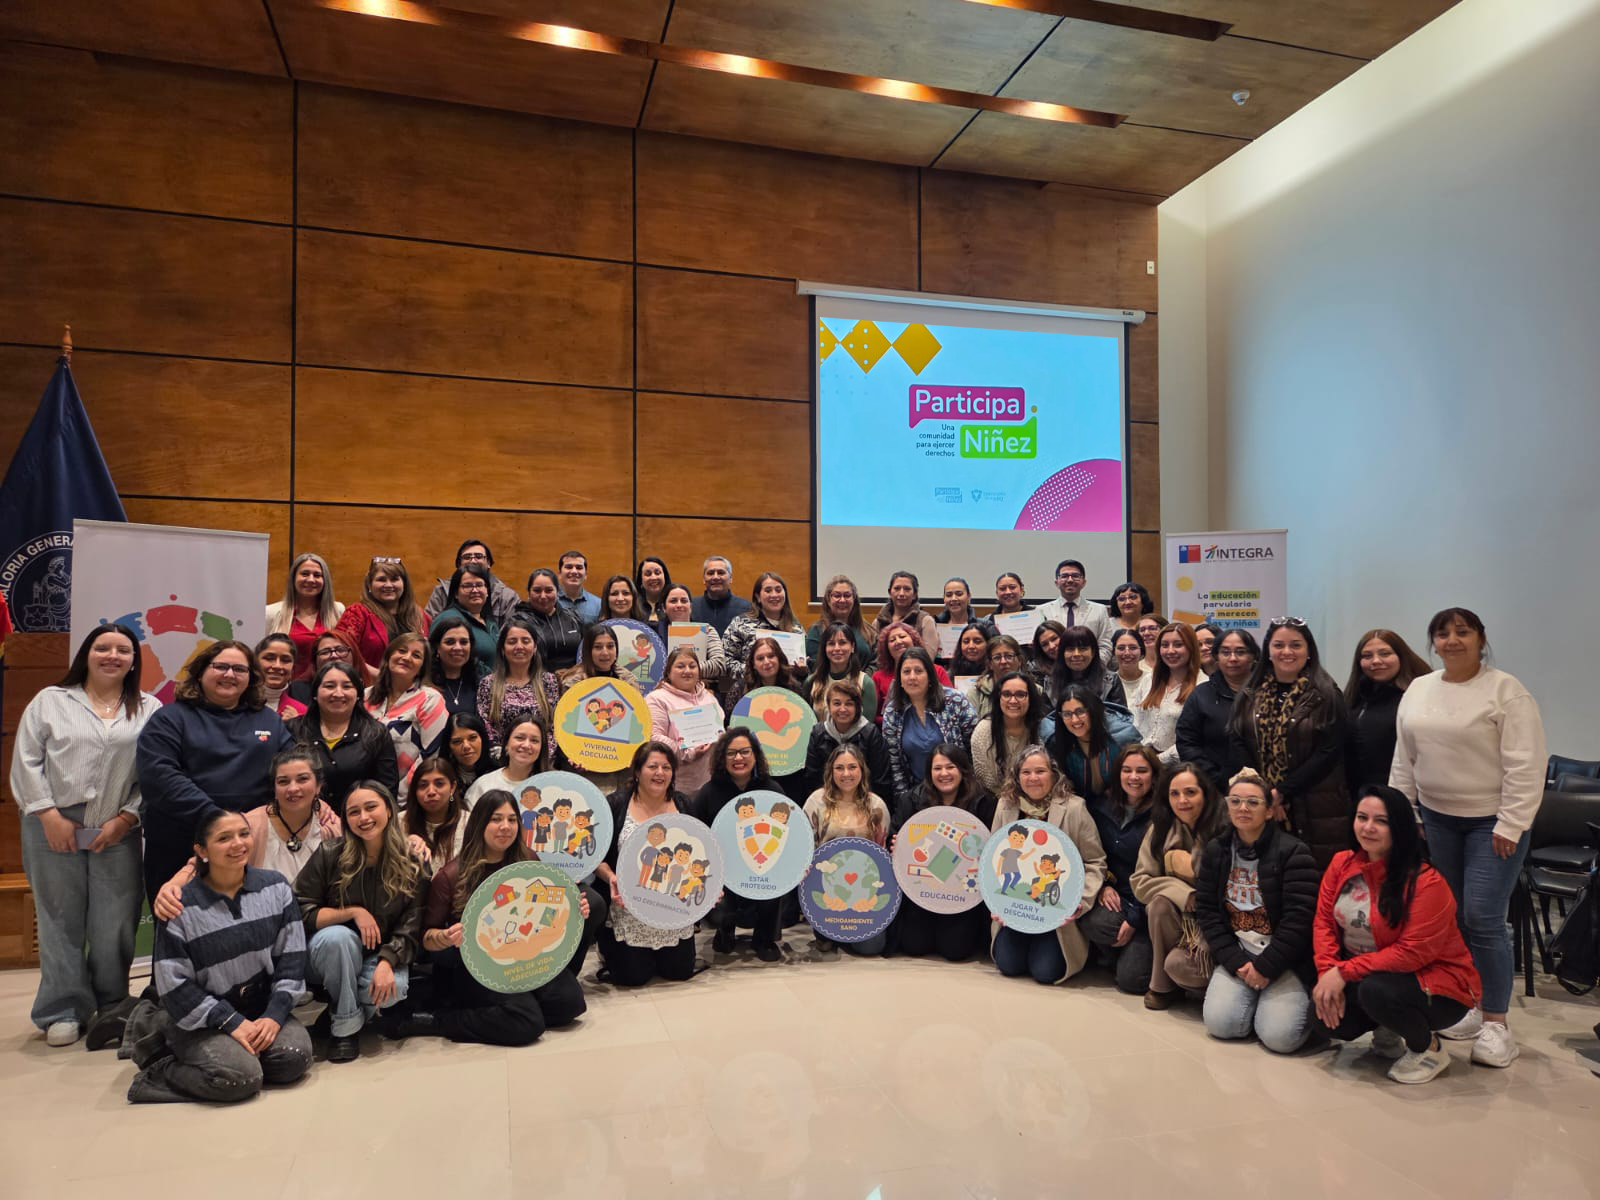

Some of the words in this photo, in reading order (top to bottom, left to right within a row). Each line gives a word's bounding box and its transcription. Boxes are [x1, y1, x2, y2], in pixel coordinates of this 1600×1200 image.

[915, 389, 1020, 419] Participa
[932, 441, 955, 449] ejercer
[964, 429, 1031, 453] Niñez
[1216, 547, 1274, 559] INTEGRA
[1211, 591, 1257, 599] educación
[1203, 600, 1252, 610] parvularia
[1233, 619, 1258, 627] niños
[583, 742, 617, 753] VIVIENDA
[579, 750, 619, 761] ADECUADA
[740, 882, 777, 891] PROTEGIDO
[1011, 902, 1034, 912] JUGAR
[1003, 907, 1045, 923] DESCANSAR
